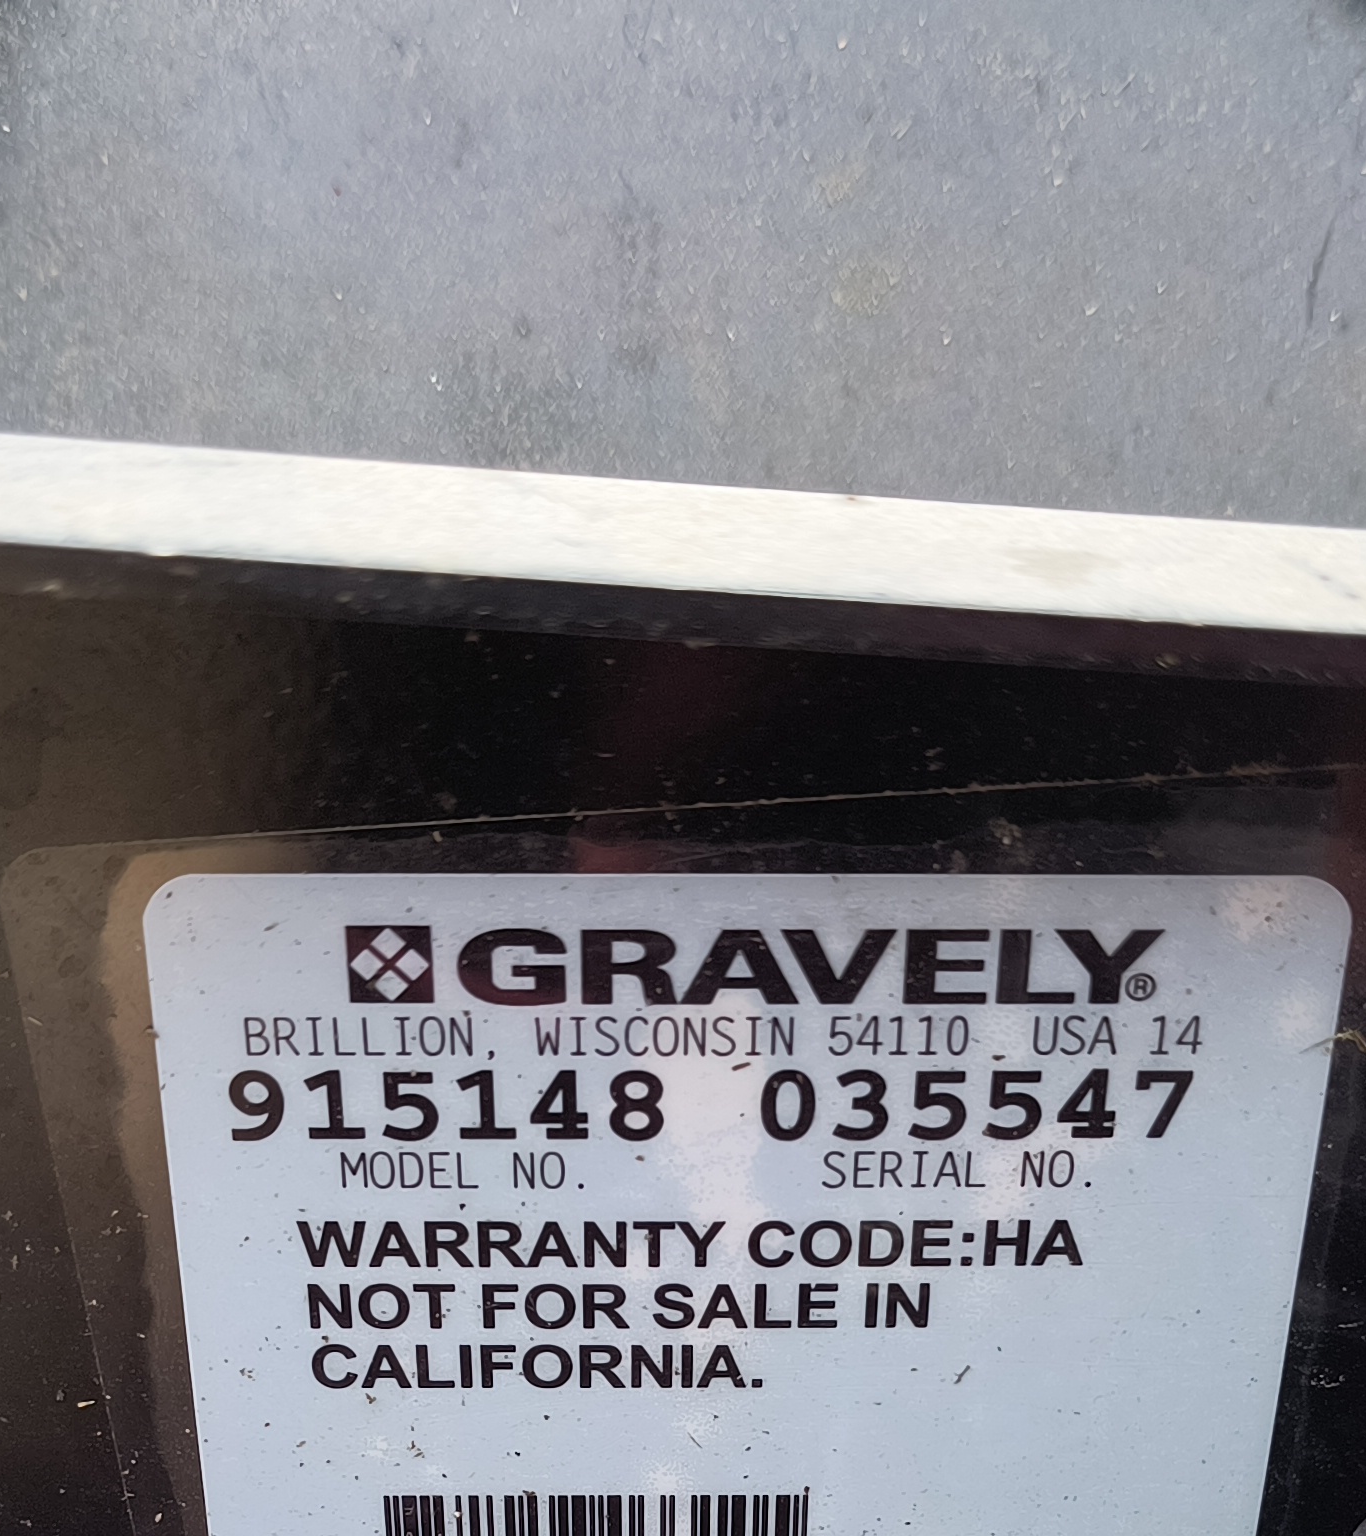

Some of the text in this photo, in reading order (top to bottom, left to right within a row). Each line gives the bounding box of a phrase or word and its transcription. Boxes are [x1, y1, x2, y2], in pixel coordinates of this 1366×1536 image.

[244, 1012, 1202, 1060] BRILLION, WISCONSIN 54110 USA 14
[229, 1068, 1194, 1141] 915148 035547
[340, 1151, 588, 1190] MODEL NO.
[822, 1150, 1091, 1188] SERIAL NO.
[296, 1219, 1083, 1268] WARRANTY CODE:HA
[307, 1283, 930, 1329] NOT FOR SALE IN
[312, 1344, 763, 1389] CALIFORNIA.
